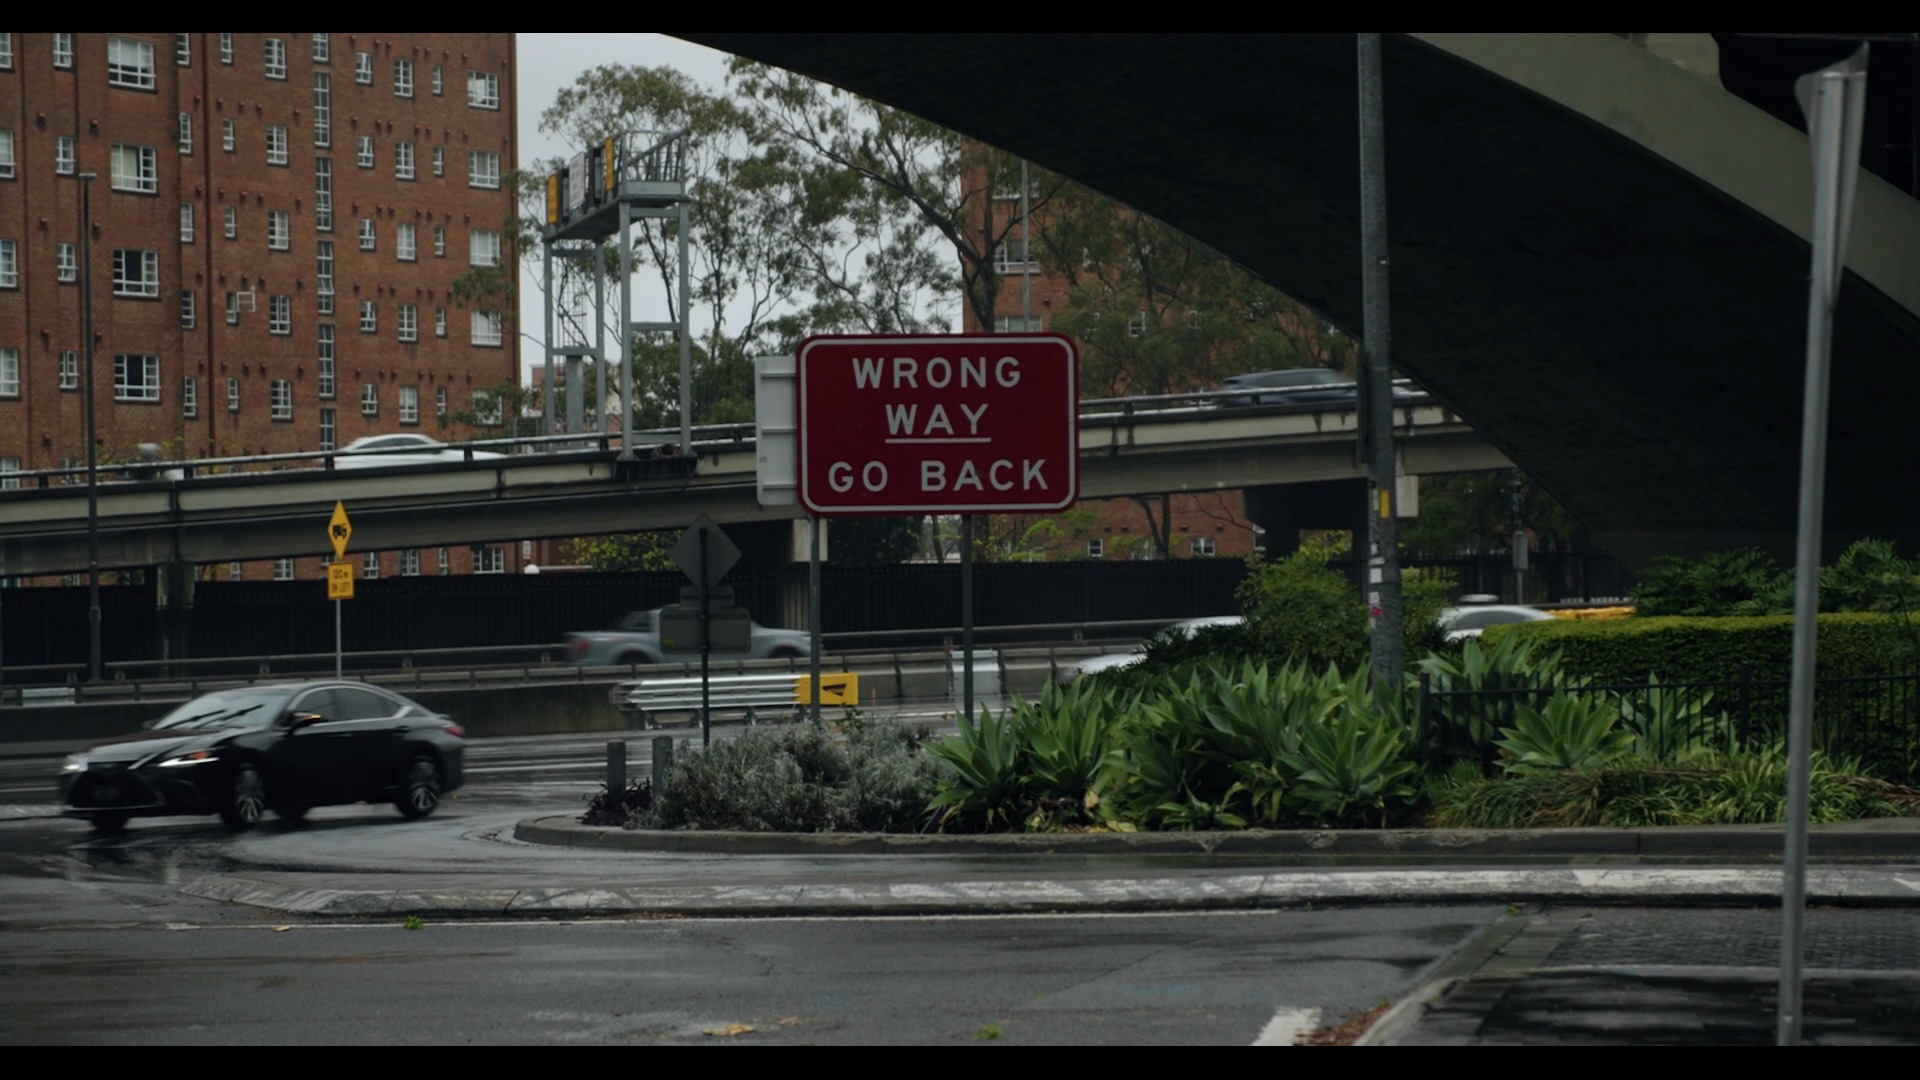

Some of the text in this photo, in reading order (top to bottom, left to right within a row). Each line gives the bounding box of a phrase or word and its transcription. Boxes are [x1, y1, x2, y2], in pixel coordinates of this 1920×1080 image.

[852, 356, 1020, 388] WRONG
[885, 404, 988, 435] WAY
[828, 459, 1048, 492] GO BACK
[339, 581, 350, 592] LEFT
